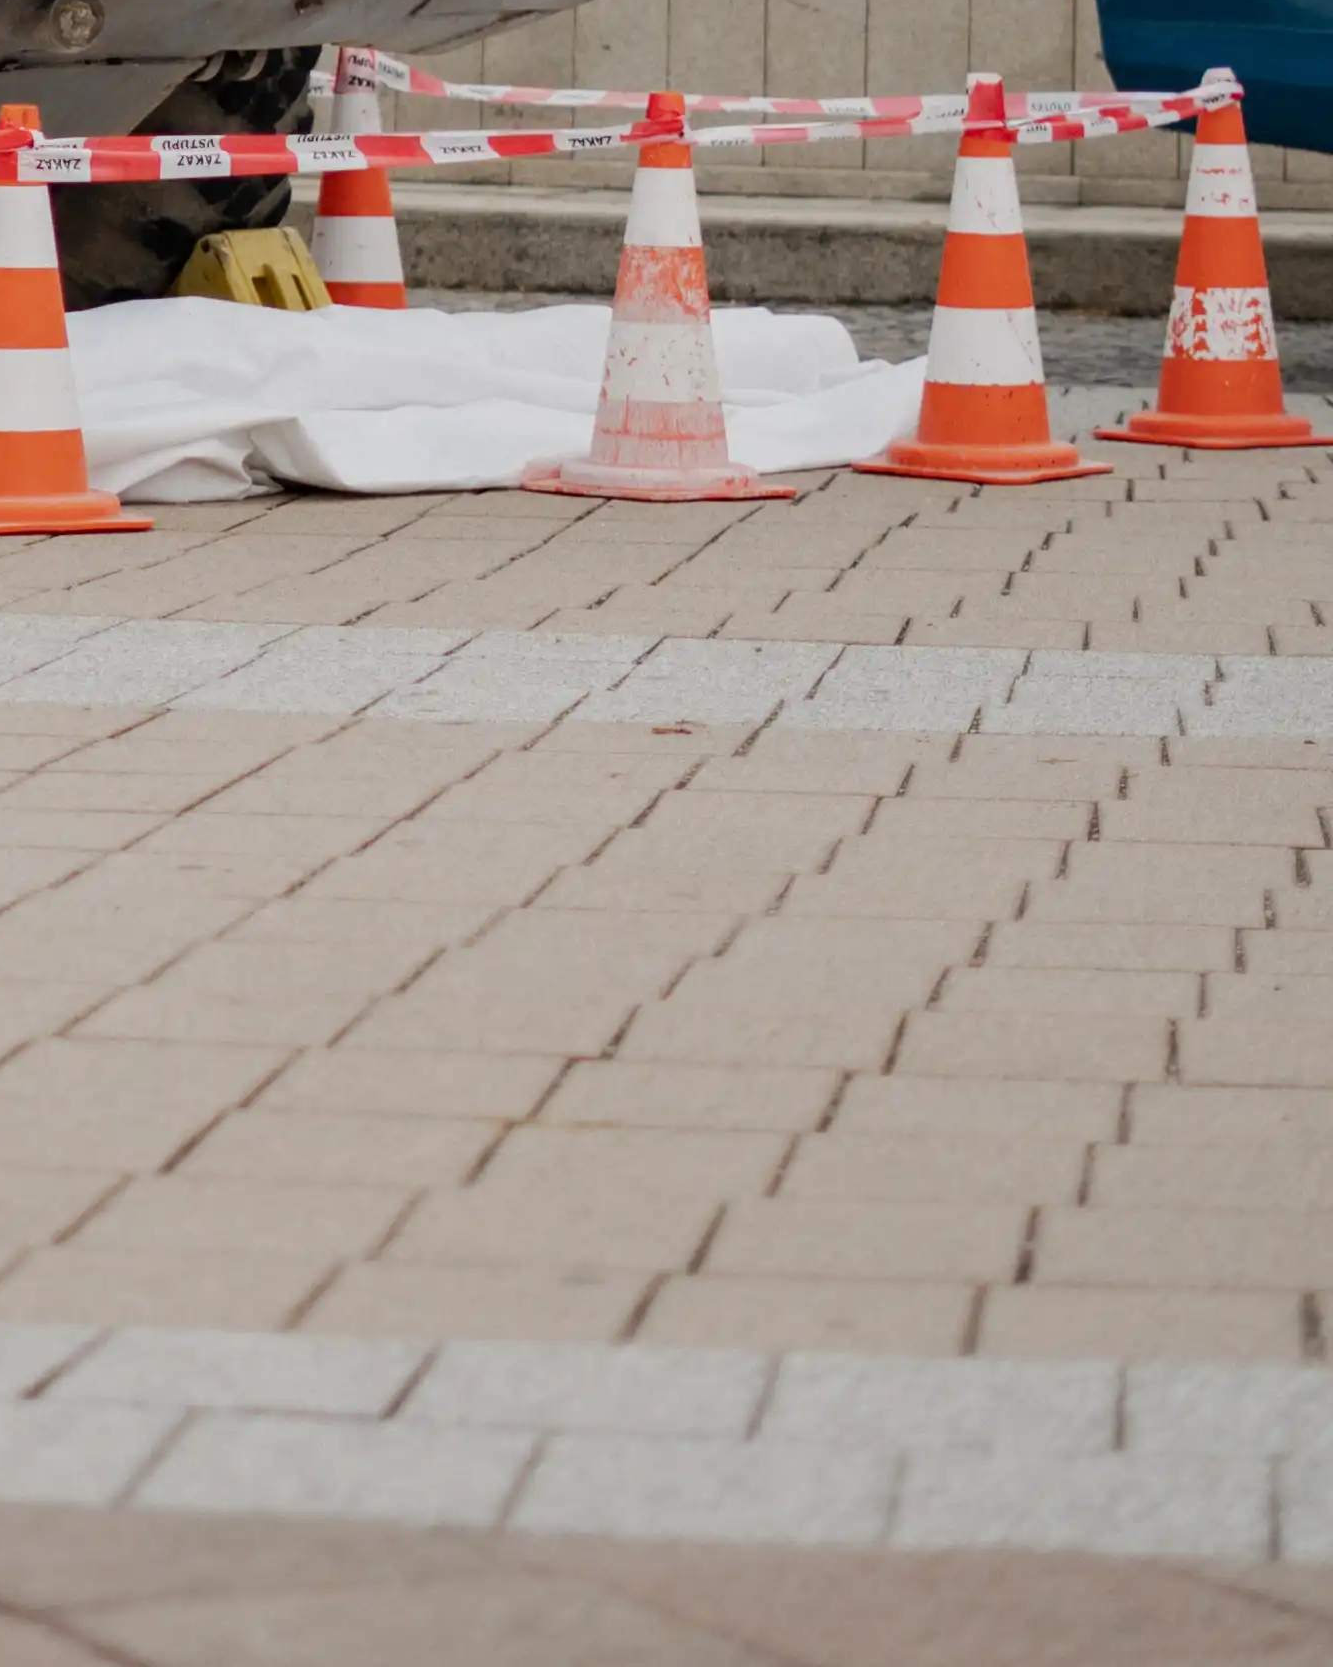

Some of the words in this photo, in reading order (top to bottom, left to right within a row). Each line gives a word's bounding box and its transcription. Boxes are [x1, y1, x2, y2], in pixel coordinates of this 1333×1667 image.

[161, 138, 215, 152] VSTUPU
[37, 158, 81, 172] ZÁKAZ
[177, 154, 222, 167] ZÁKAZ
